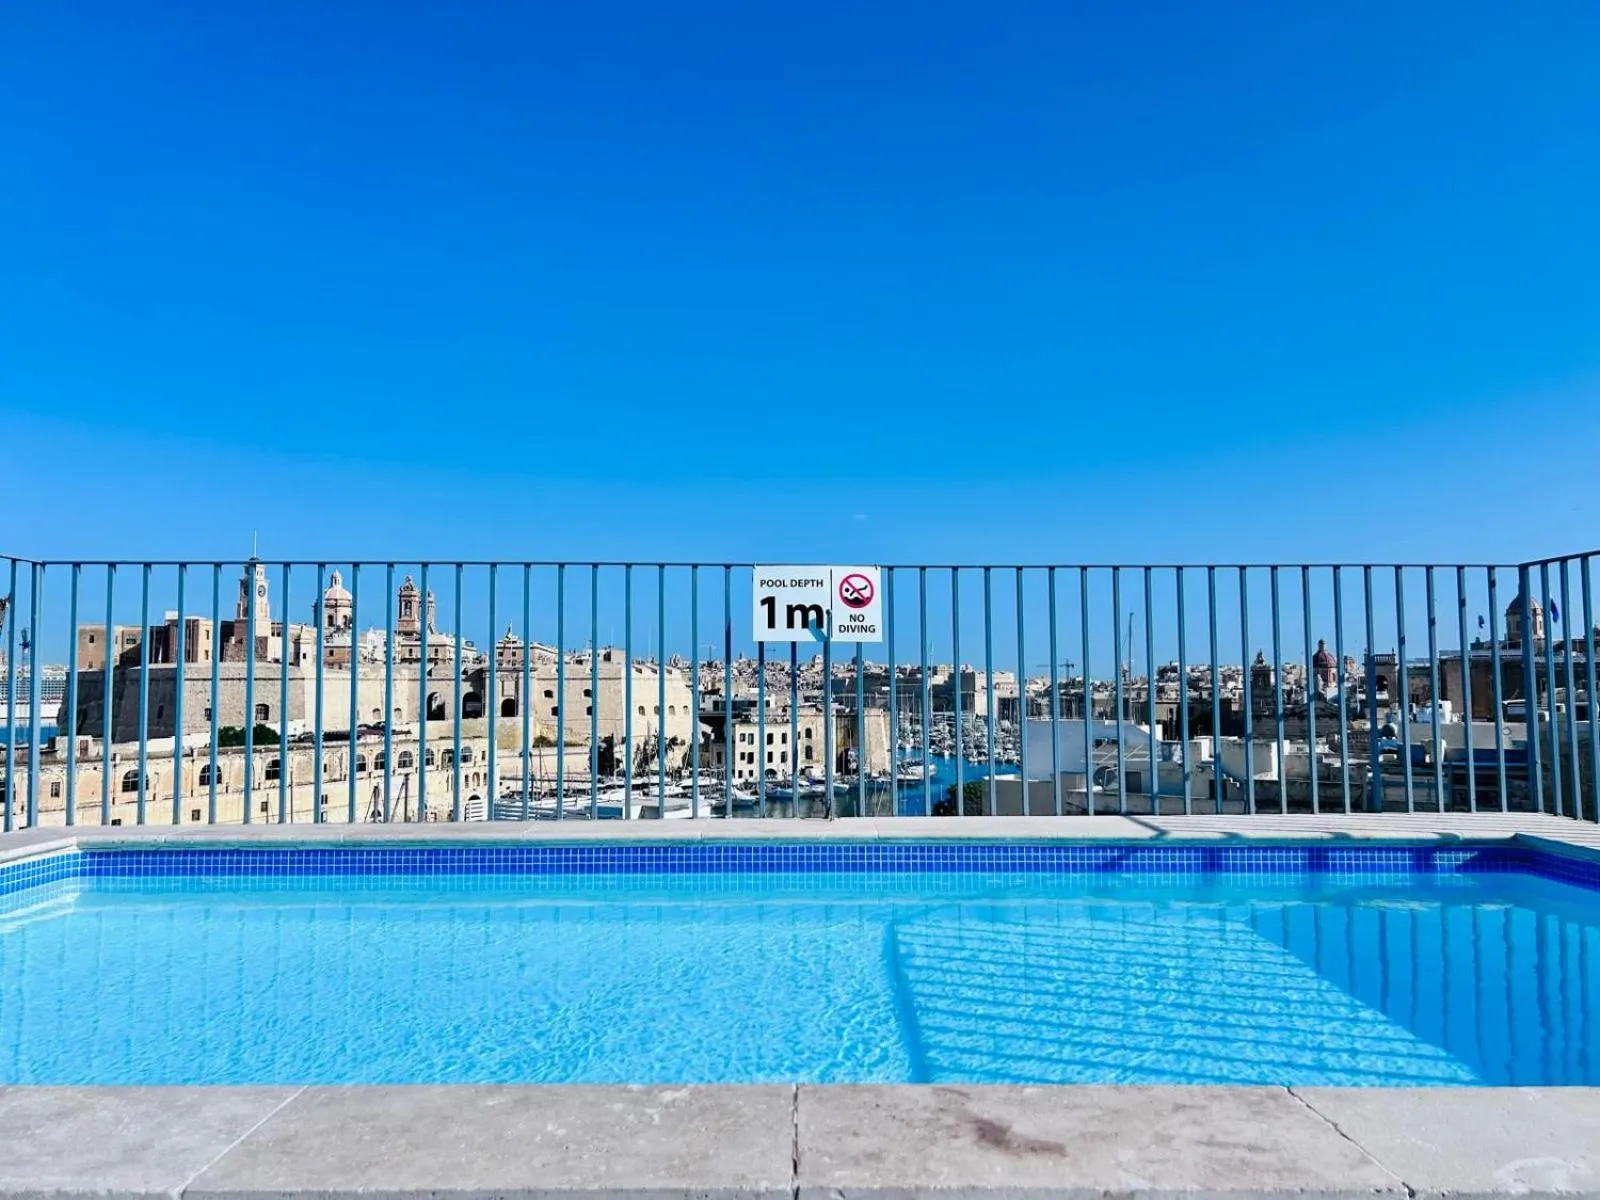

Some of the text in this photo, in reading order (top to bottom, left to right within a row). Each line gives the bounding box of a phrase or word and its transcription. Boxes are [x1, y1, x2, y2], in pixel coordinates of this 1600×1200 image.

[760, 579, 824, 588] POOL DEPTH
[849, 613, 865, 623] NO
[838, 624, 876, 634] DIVING
